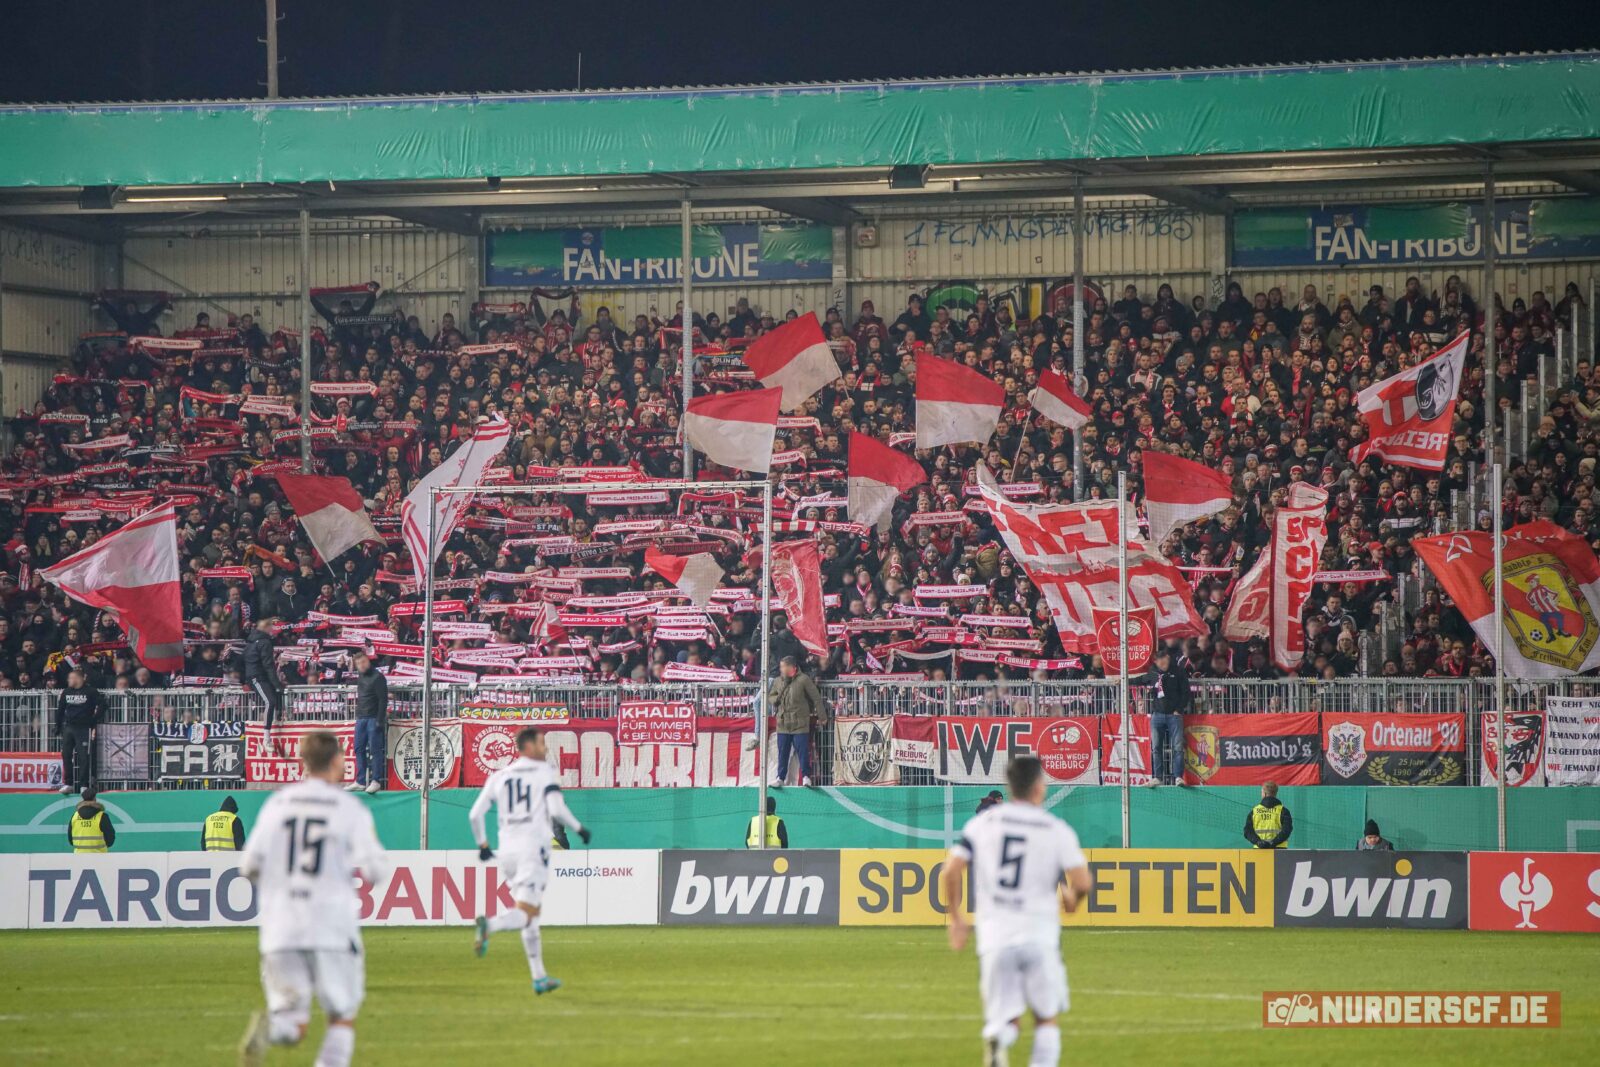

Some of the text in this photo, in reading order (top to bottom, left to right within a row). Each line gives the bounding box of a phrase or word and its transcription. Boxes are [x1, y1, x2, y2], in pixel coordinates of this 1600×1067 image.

[1106, 651, 1146, 661] FREURG
[622, 706, 692, 719] KHALID
[621, 719, 692, 730] FÜR IMMER
[631, 731, 682, 741] BEI UNS
[1372, 720, 1432, 747] Ortenau
[1549, 730, 1580, 740] JEMAND
[895, 750, 928, 759] FREIBURG
[1224, 736, 1313, 762] Knaddly's
[1040, 753, 1089, 761] IMMER WIEDER
[1045, 760, 1085, 771] FREIBURG
[1564, 764, 1595, 772] JEMAND
[1104, 775, 1137, 786] ALWYS
[504, 777, 531, 813] 14
[284, 817, 326, 877] 15
[998, 835, 1026, 890] 5
[670, 857, 824, 915] bwin
[1285, 859, 1451, 918] bwin
[29, 868, 260, 922] TARGO
